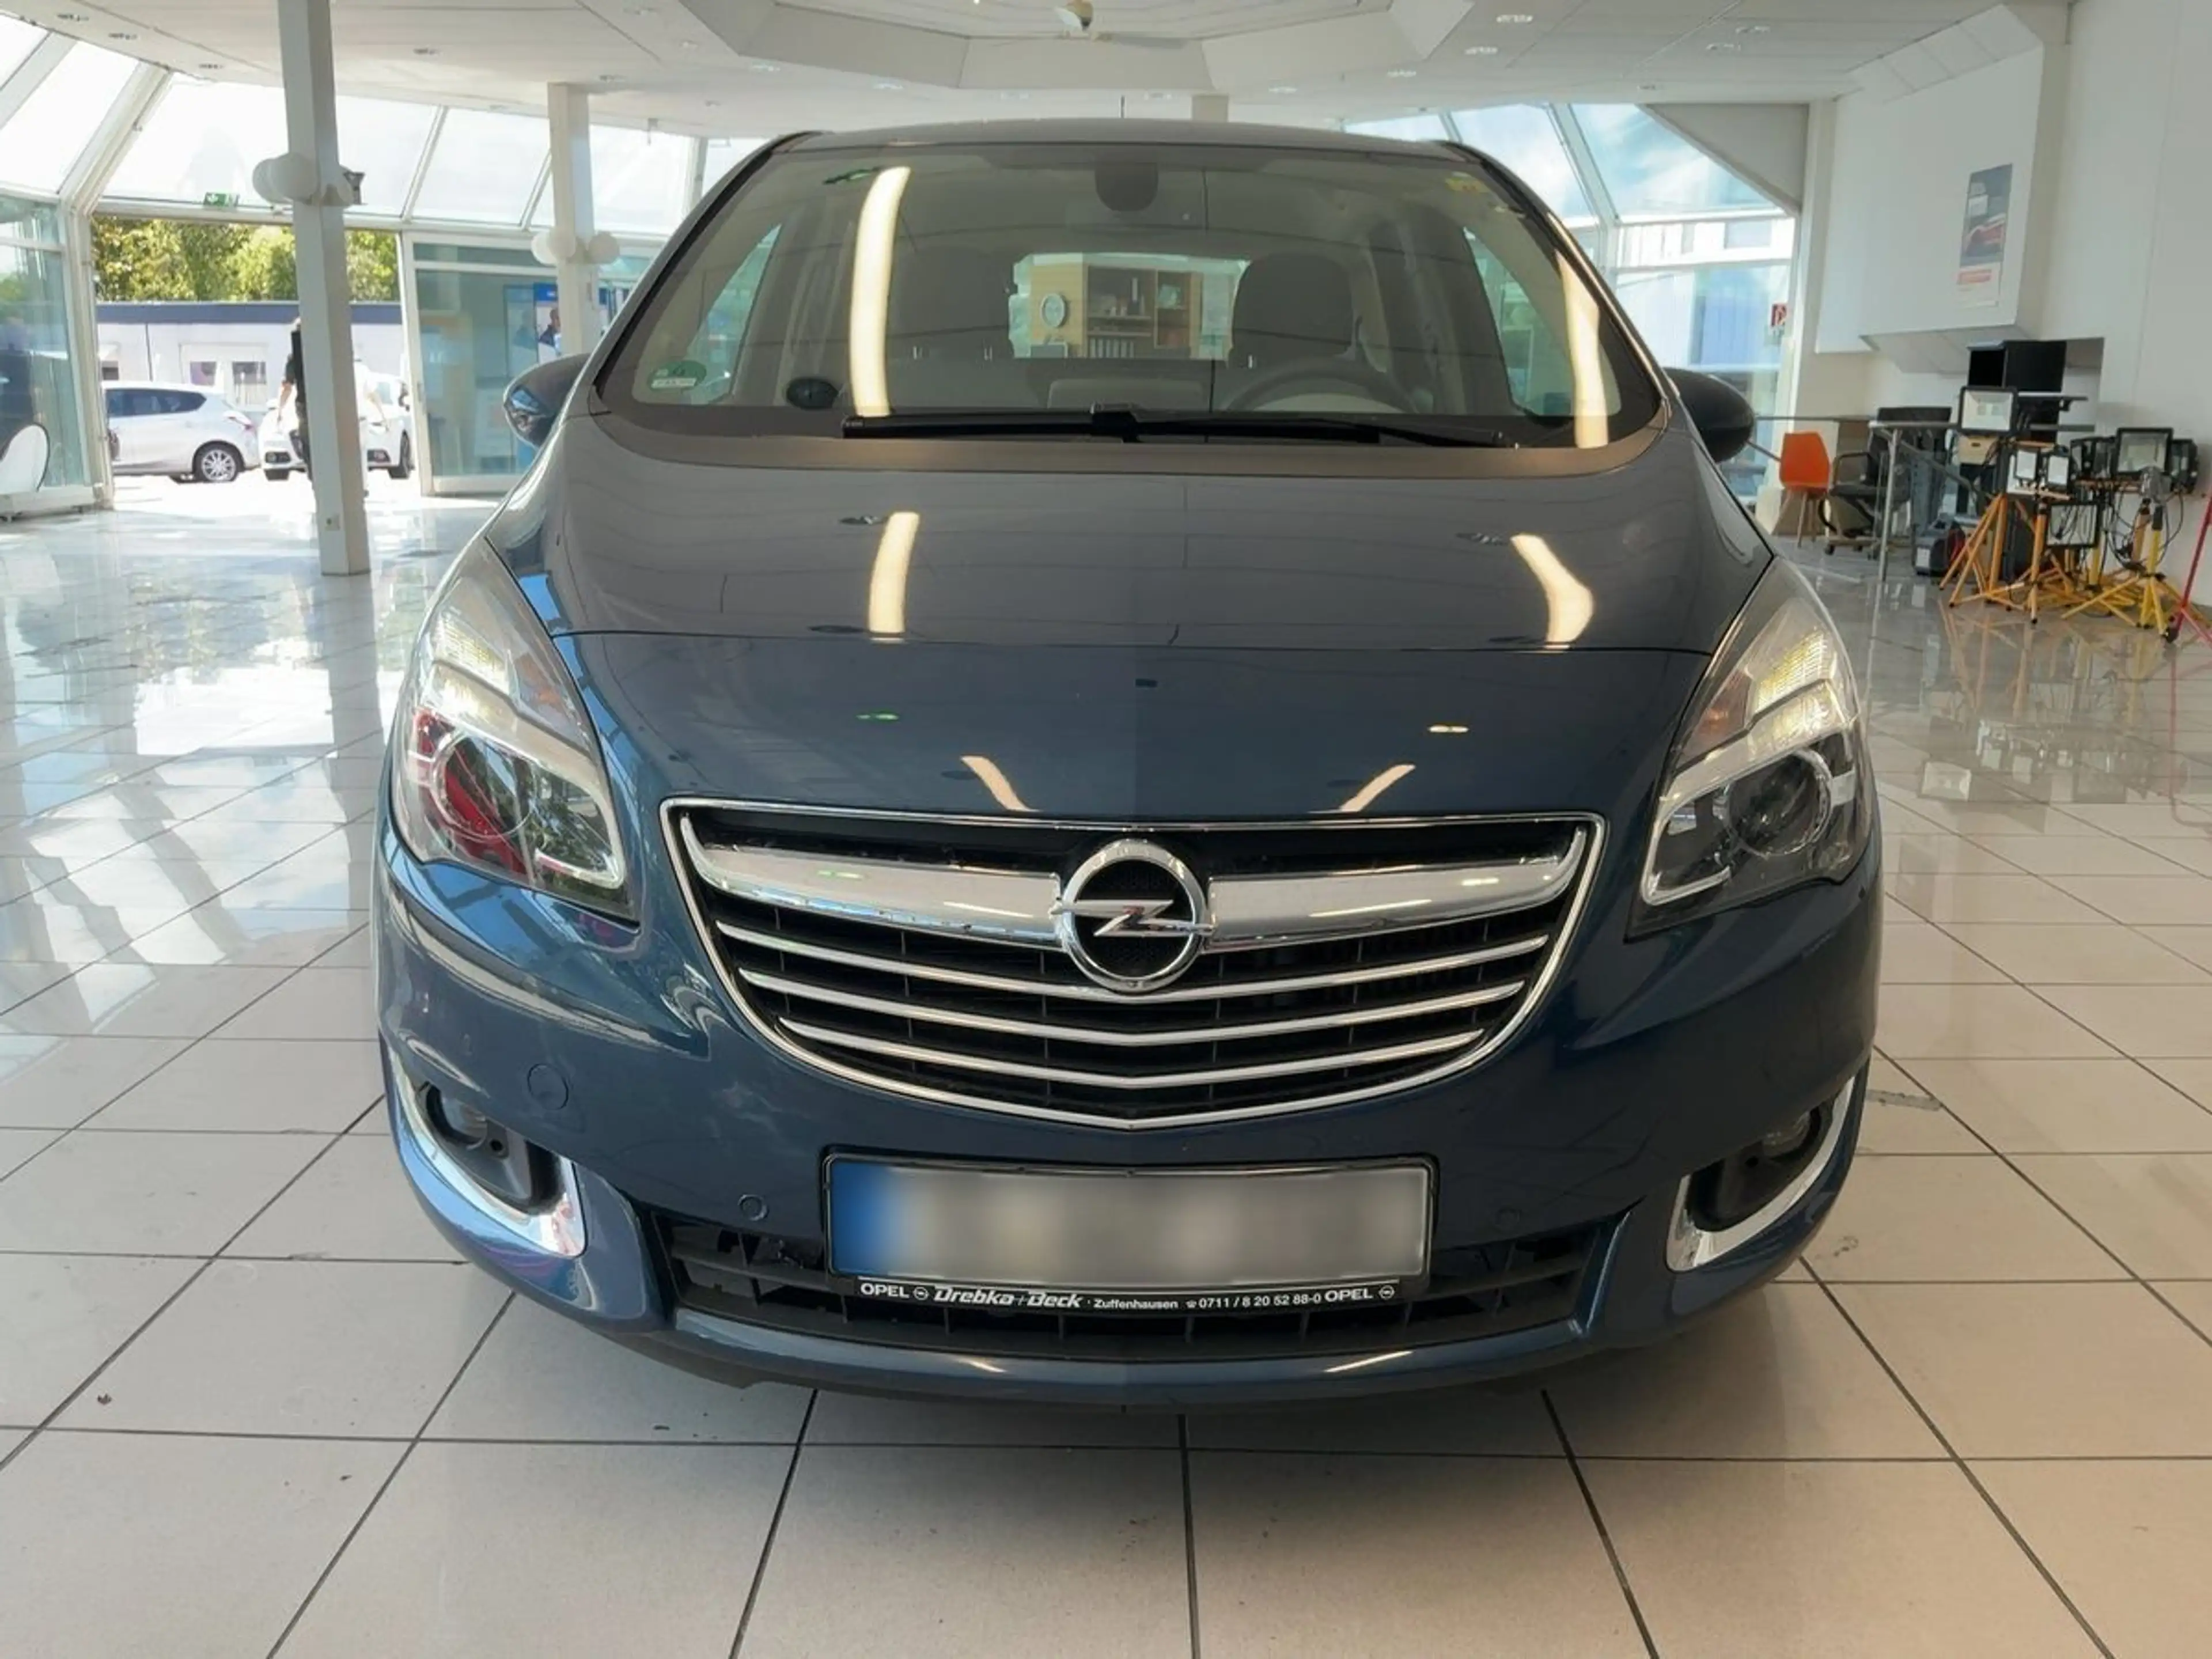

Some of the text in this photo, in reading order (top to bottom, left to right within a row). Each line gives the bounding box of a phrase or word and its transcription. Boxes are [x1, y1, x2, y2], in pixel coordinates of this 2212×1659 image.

[861, 1282, 910, 1298] OPEL
[1093, 1298, 1179, 1309] Zuffenhausen
[1198, 1297, 1229, 1309] 0711
[1324, 1287, 1373, 1302] OPEL
